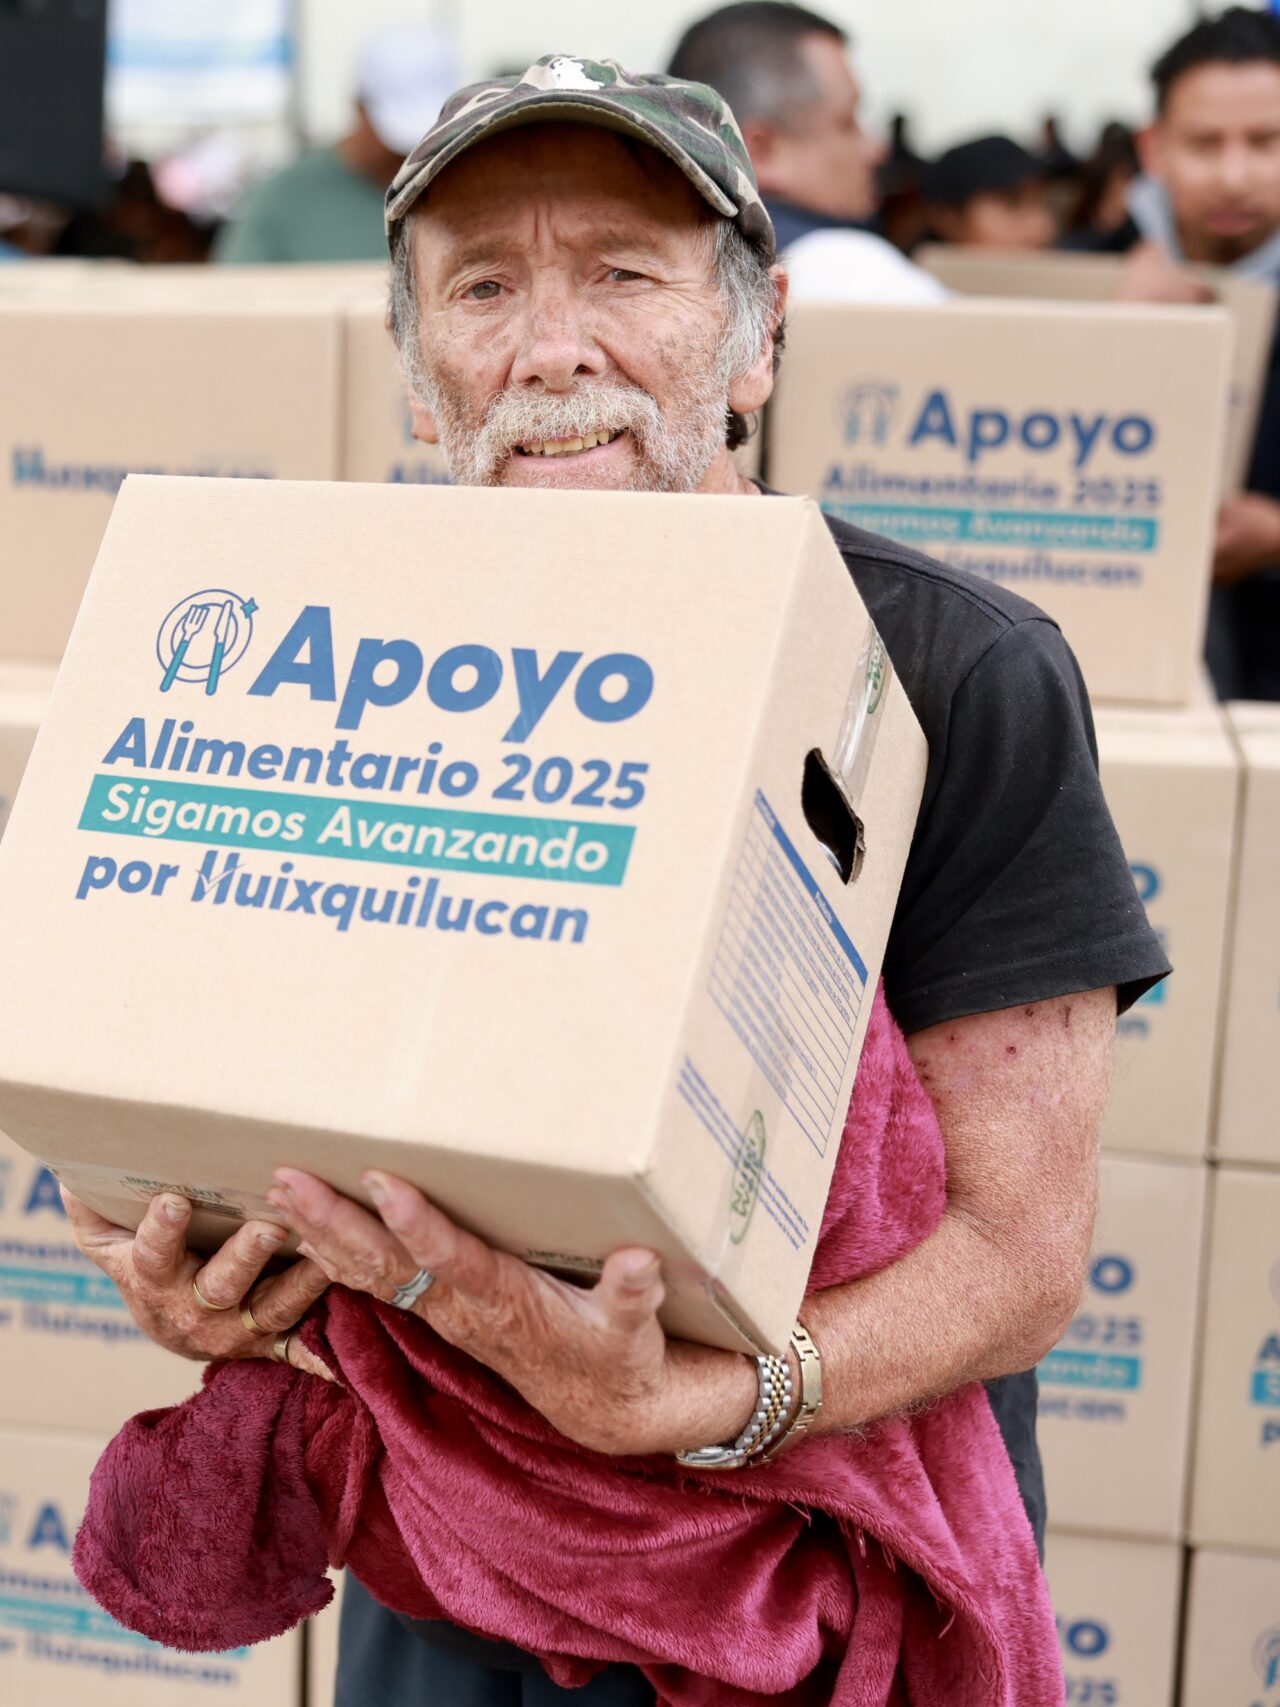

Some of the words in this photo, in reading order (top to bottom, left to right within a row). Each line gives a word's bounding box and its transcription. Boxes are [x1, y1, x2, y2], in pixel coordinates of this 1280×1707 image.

[907, 388, 1157, 469] Apoyo
[247, 605, 654, 743] Apoyo
[101, 716, 479, 797] Alimentario
[492, 753, 648, 809] 2025
[101, 782, 305, 840] Sigamos
[316, 805, 608, 871] Avanzando
[75, 855, 179, 900] por
[191, 849, 588, 942] Huixquilucan
[1070, 1314, 1144, 1345] 025
